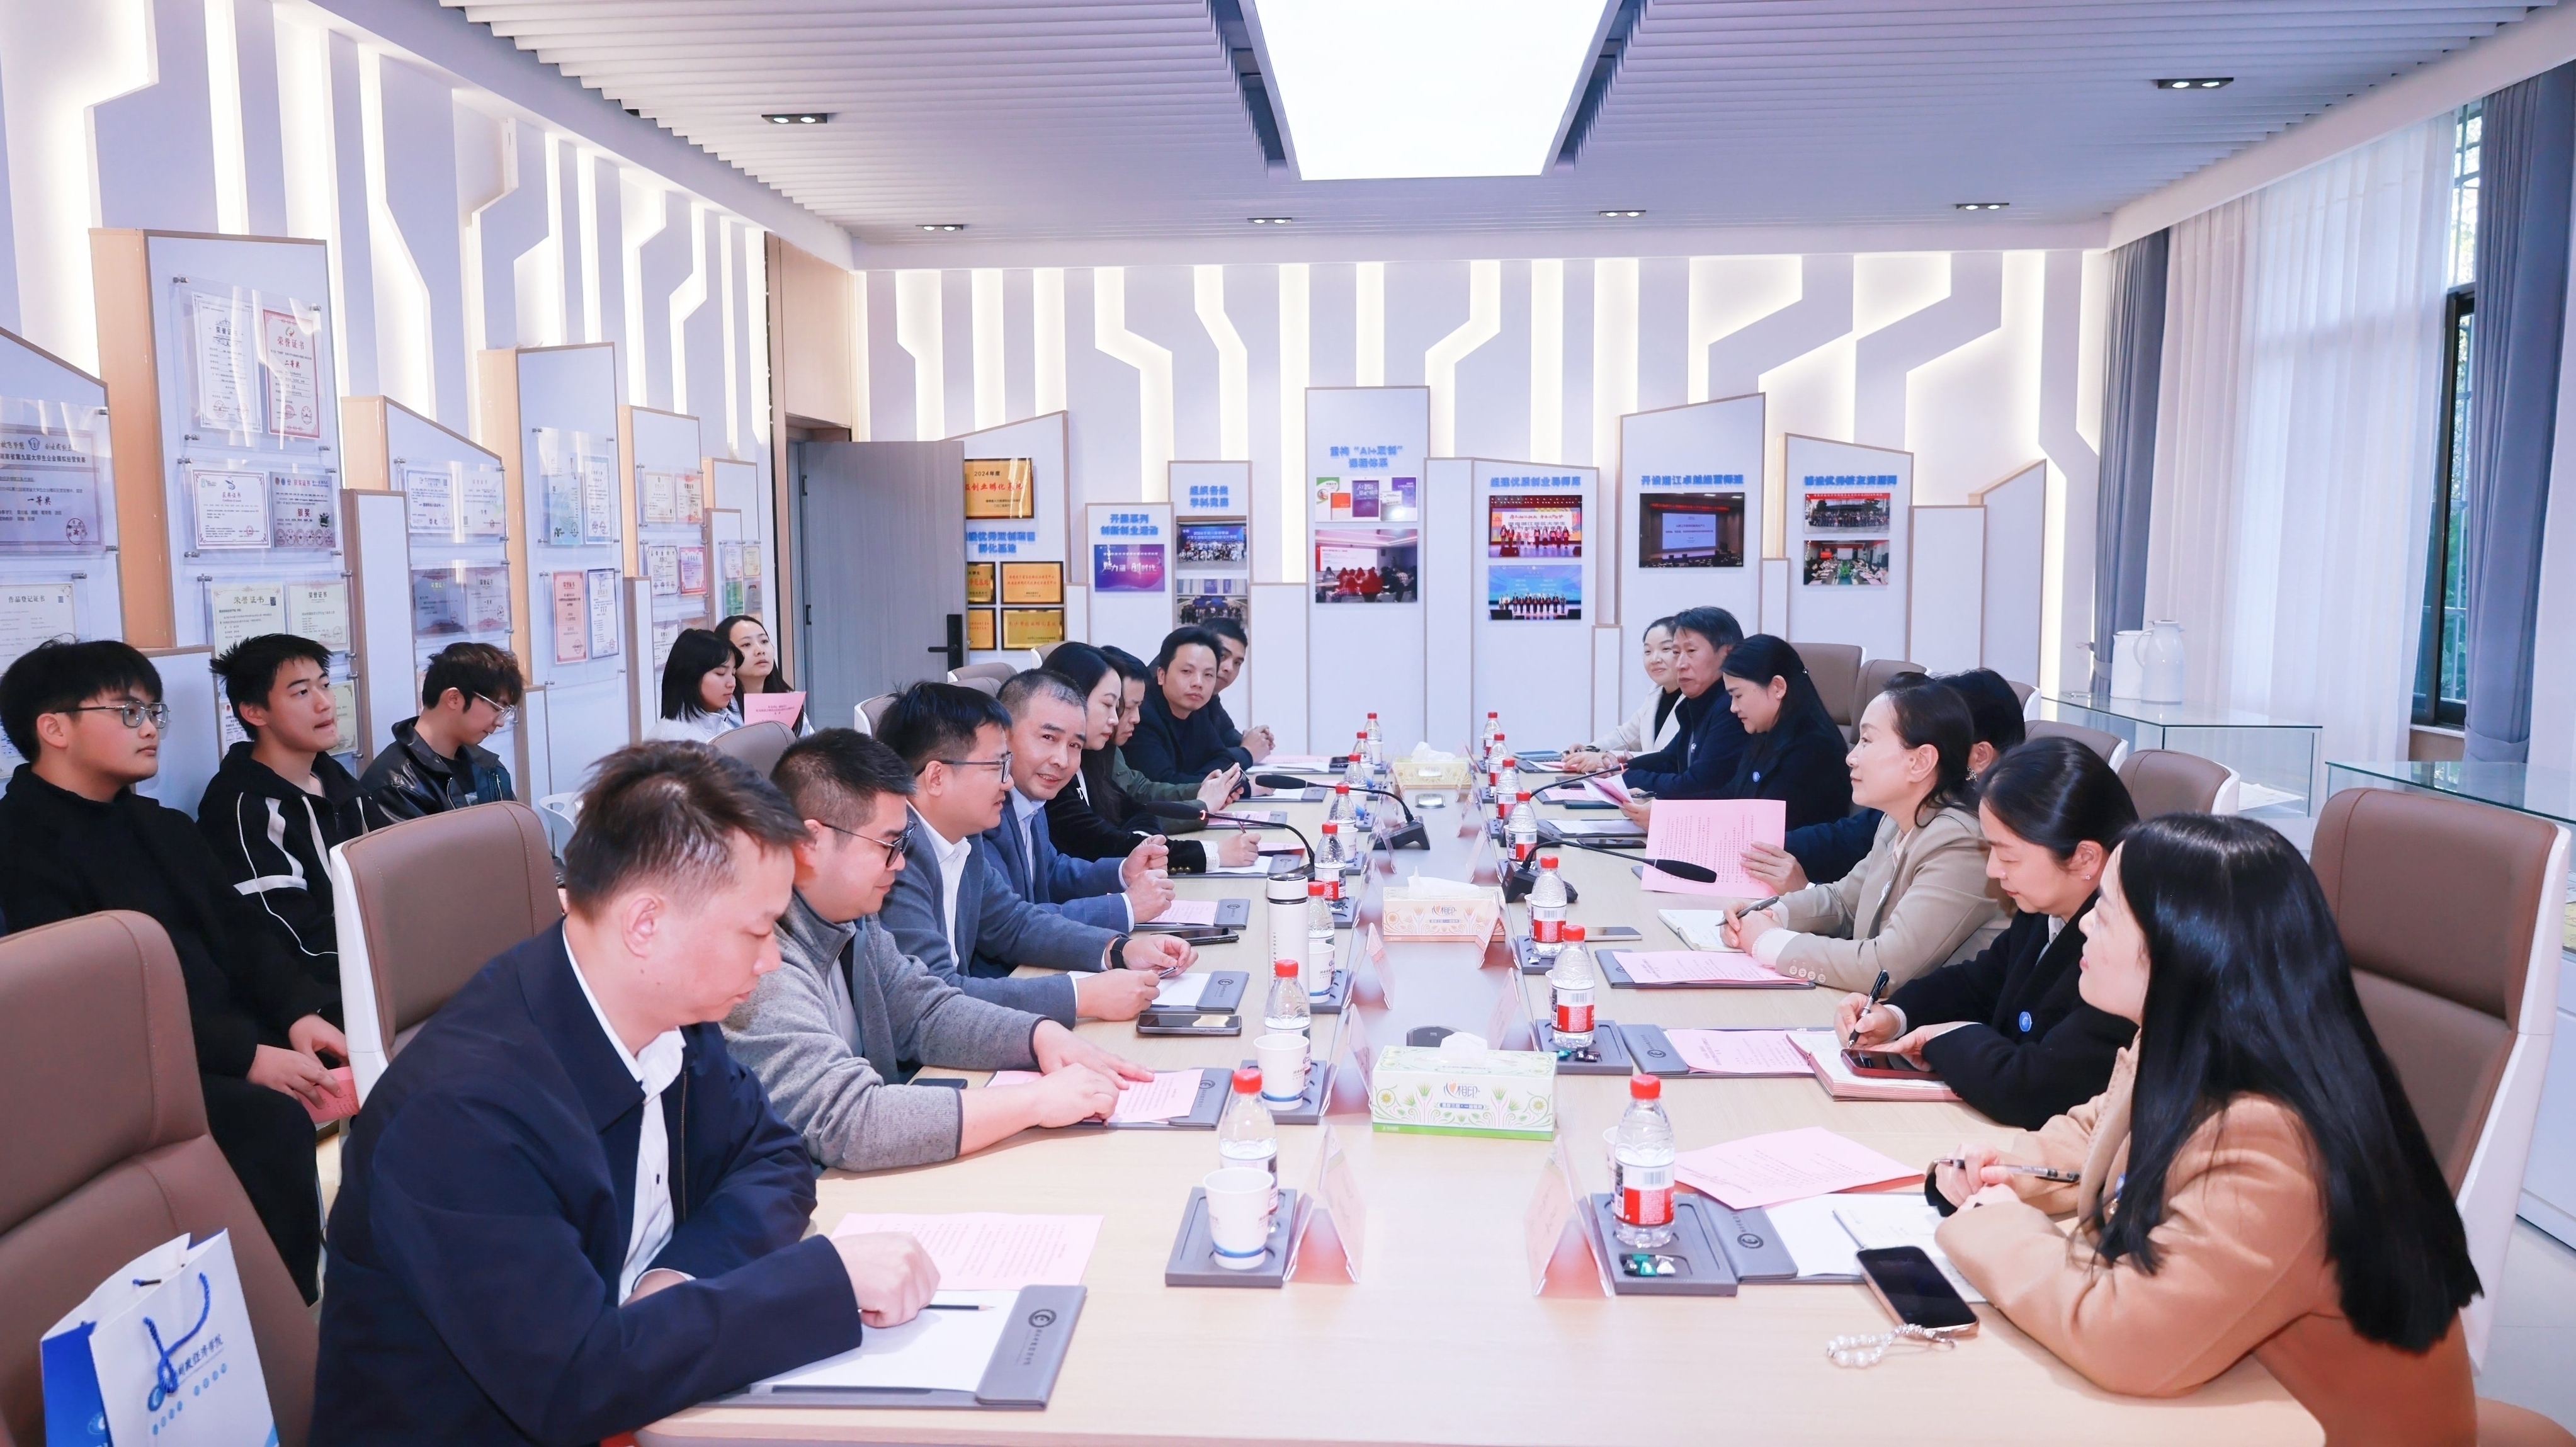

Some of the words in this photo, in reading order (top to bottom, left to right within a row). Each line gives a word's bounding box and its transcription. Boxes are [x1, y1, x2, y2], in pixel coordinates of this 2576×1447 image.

[277, 336, 304, 350] 荣誉证书
[285, 360, 300, 369] 二等奖
[27, 496, 52, 506] 一等奖
[297, 508, 310, 517] 银奖
[8, 595, 45, 603] 作品登记证书
[234, 596, 264, 604] 荣誉证书
[1444, 1079, 1480, 1098] 心相印
